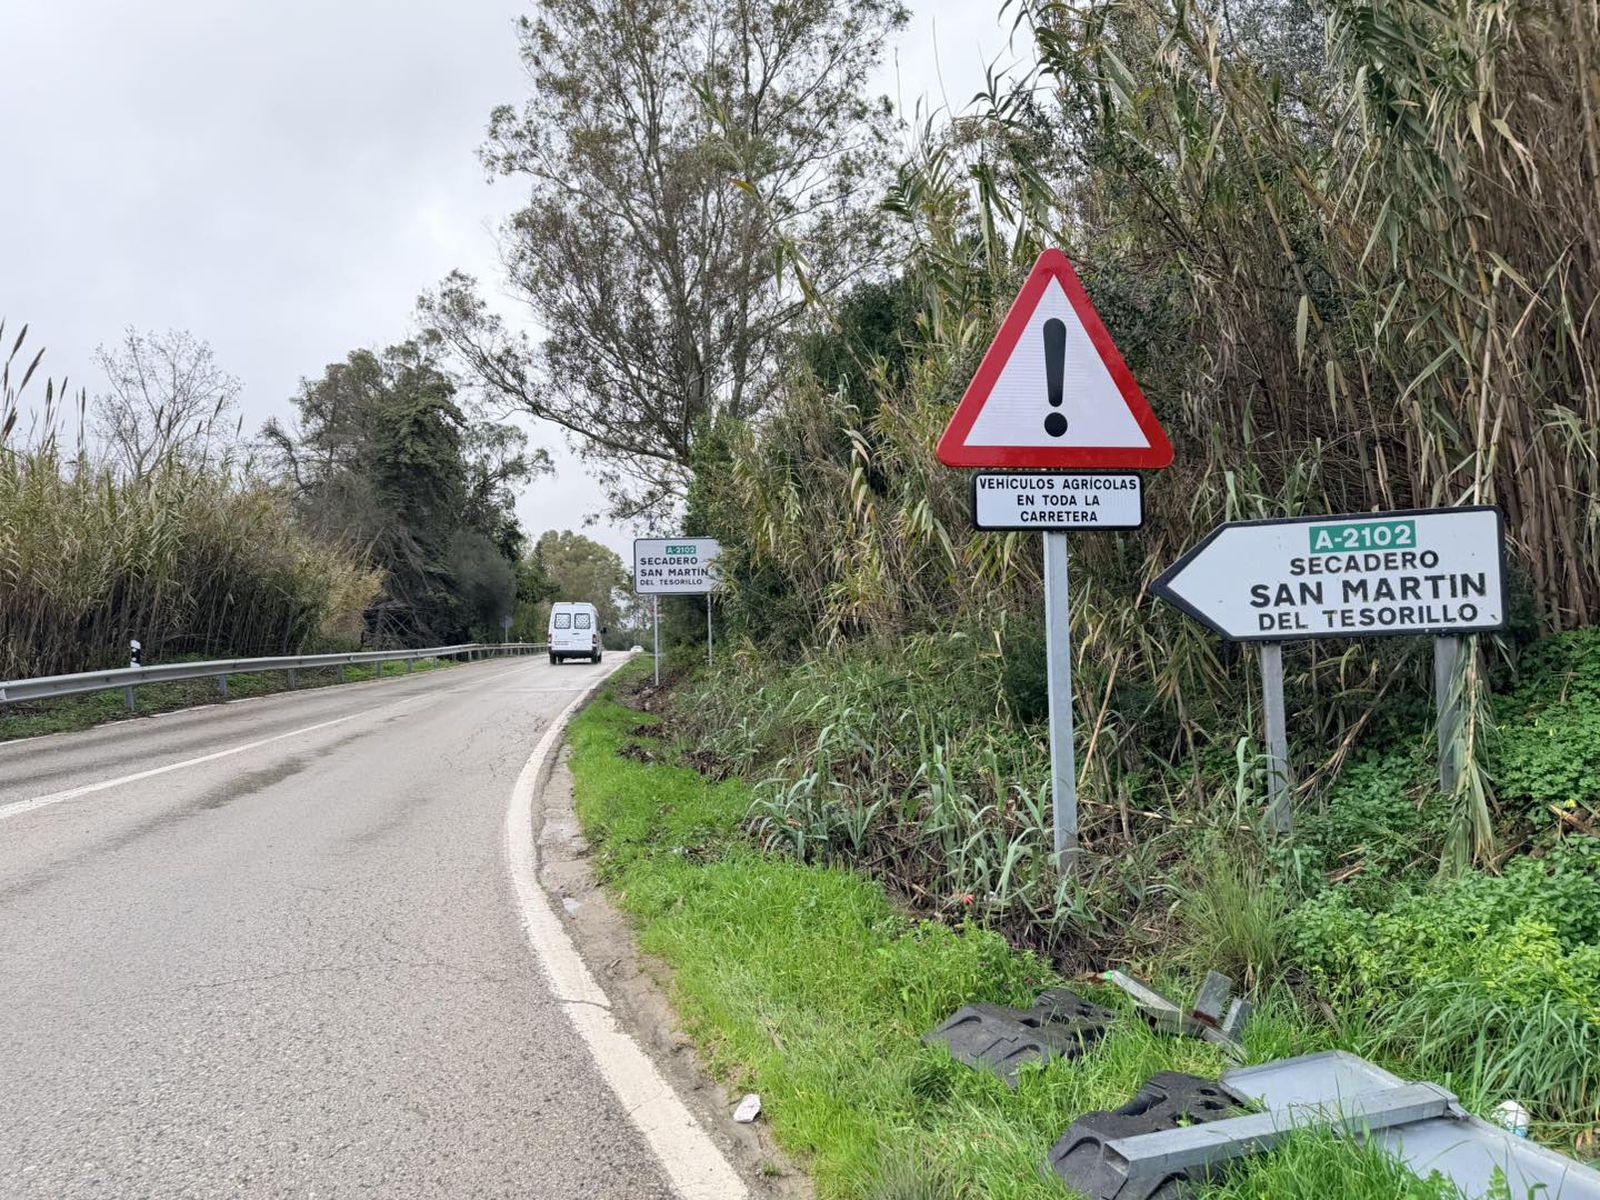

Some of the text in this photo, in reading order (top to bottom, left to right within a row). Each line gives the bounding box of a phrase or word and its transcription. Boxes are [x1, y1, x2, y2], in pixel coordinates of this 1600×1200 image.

[979, 475, 1137, 490] VEHÍCULOS AGRÍCOLAS
[1017, 495, 1100, 506] EN TODA LA
[1020, 511, 1098, 522] CARRETERA
[1315, 524, 1412, 550] A-2102
[640, 557, 698, 565] SECADERO
[1290, 550, 1439, 576] SECADERO
[640, 569, 662, 577] SAN
[1250, 572, 1487, 608] SAN MARTIN
[1258, 603, 1478, 631] DEL TESORILLO
